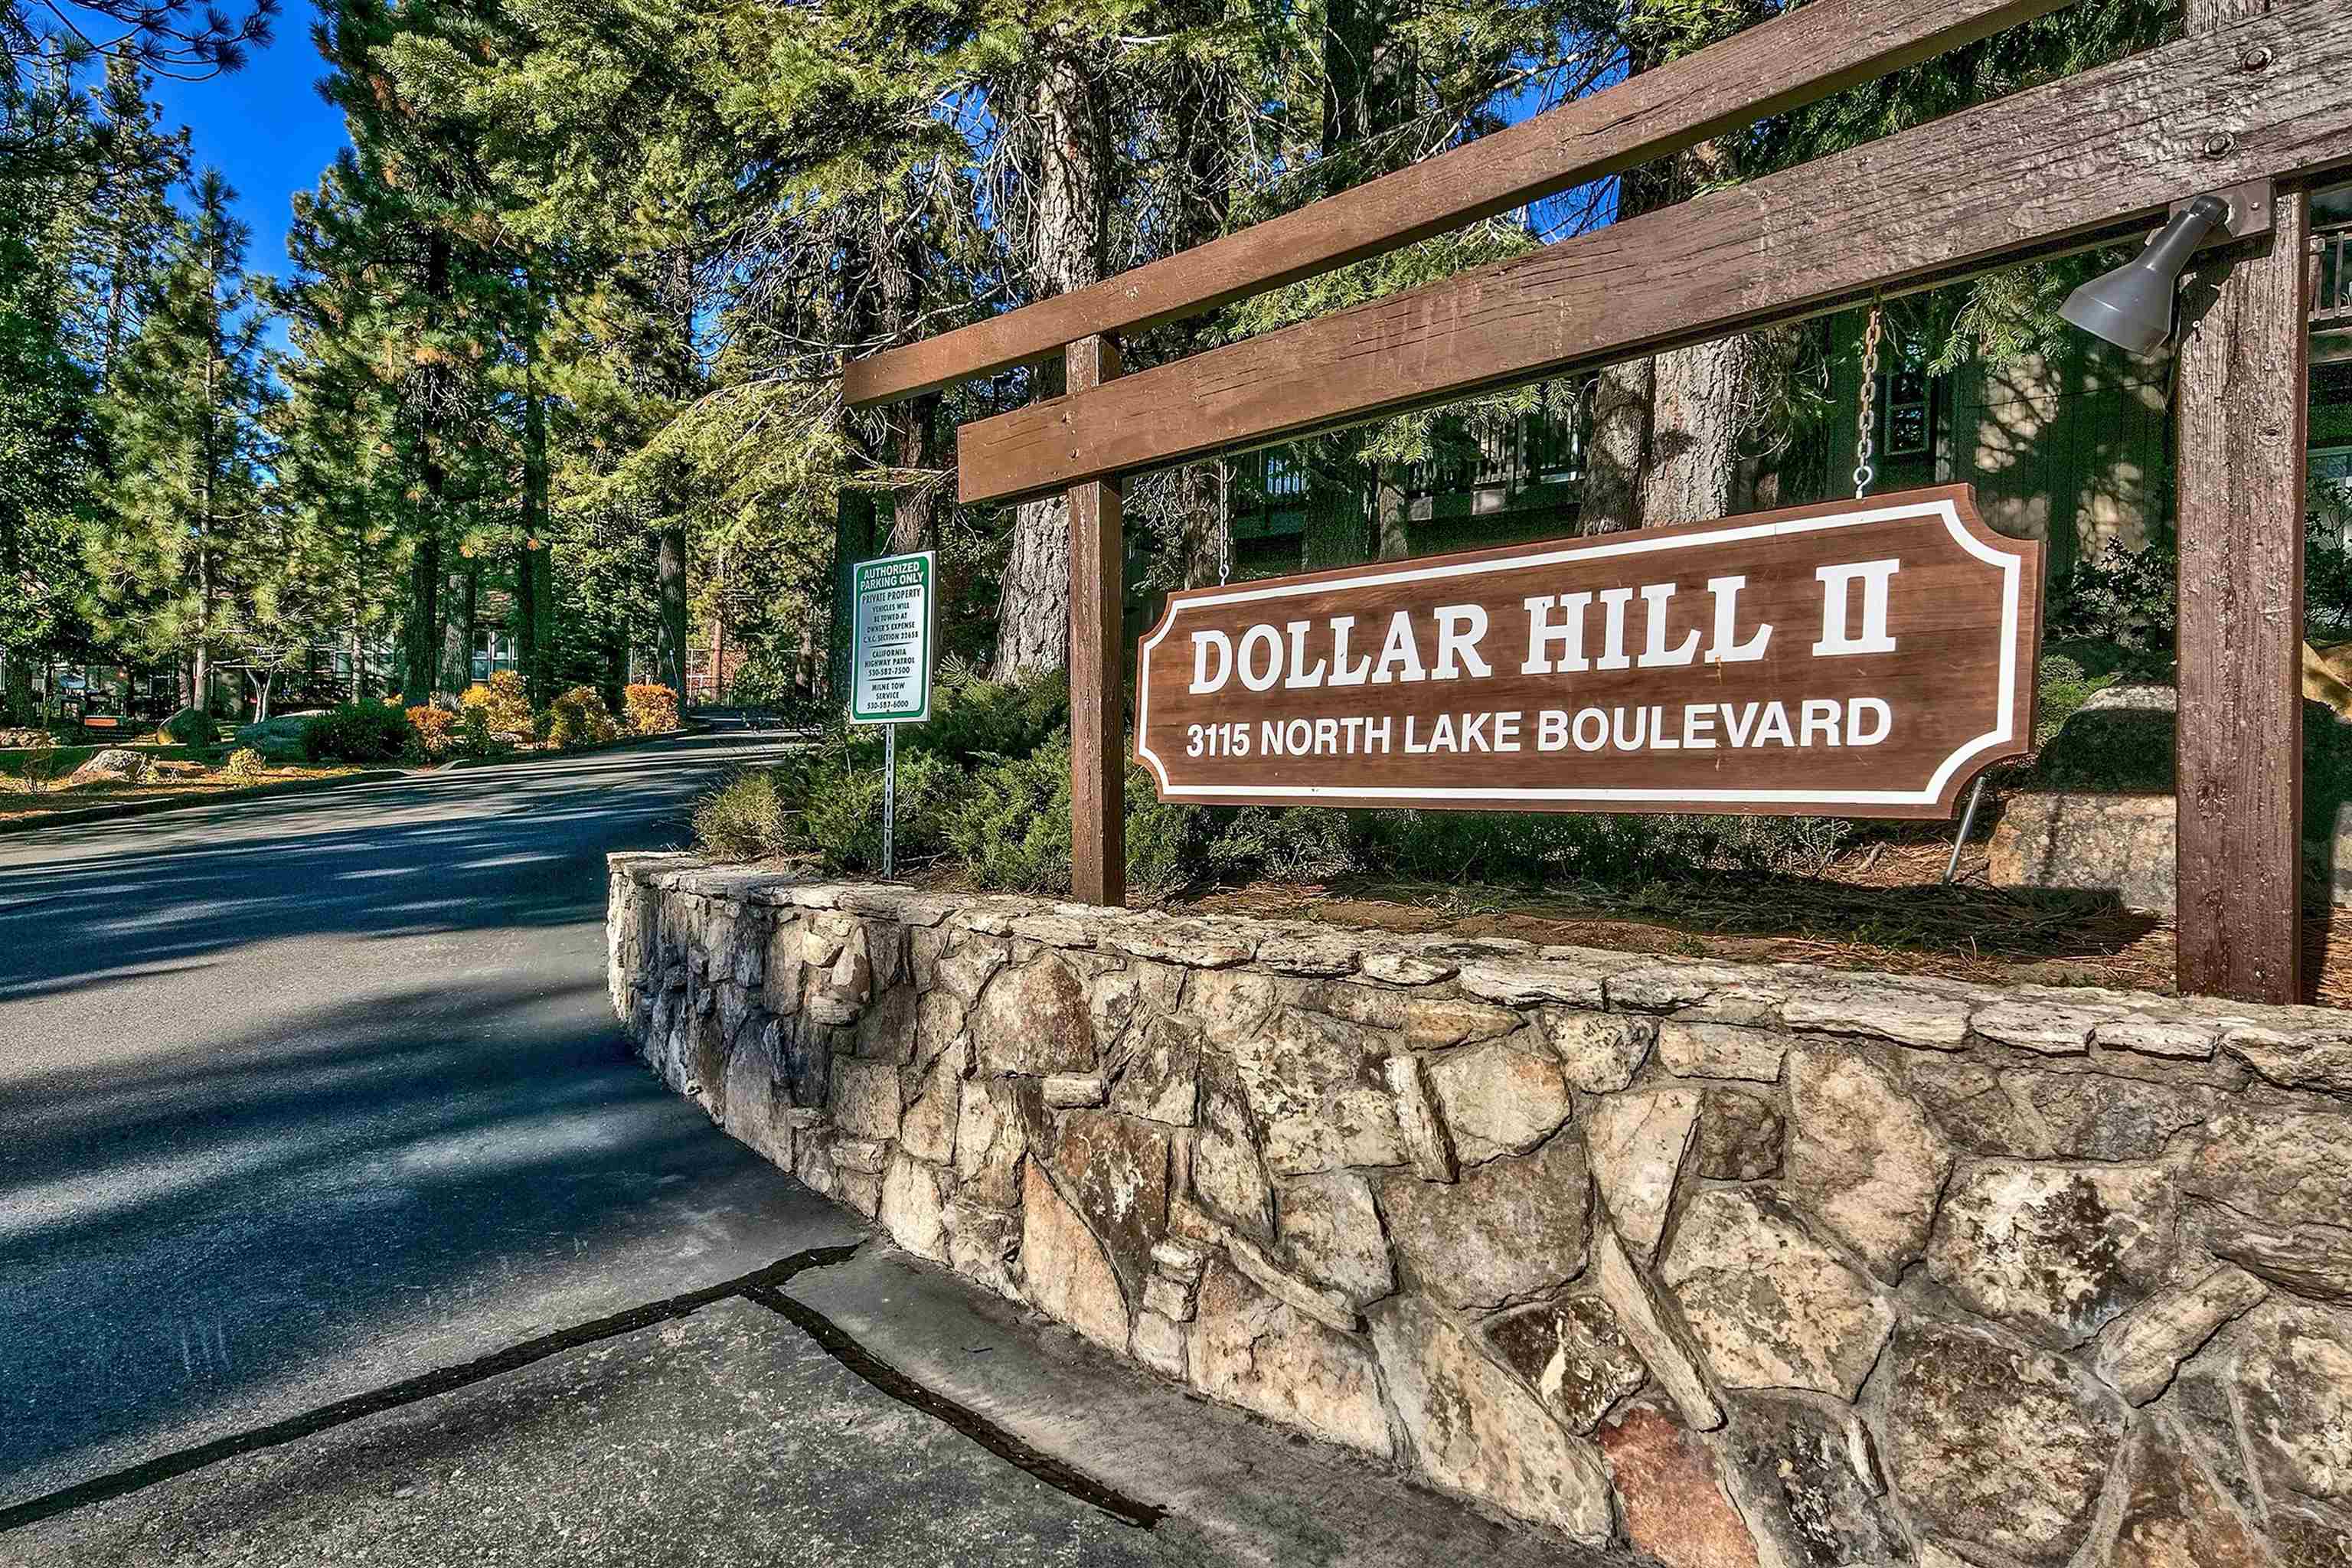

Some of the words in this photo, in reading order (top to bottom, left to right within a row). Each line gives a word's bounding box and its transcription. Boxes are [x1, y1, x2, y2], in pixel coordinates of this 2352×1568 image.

[864, 561, 920, 580] AUTHORIZED
[861, 576, 897, 591] PARKING
[900, 571, 924, 585] ONLY
[862, 593, 886, 605] PRIVATE
[887, 588, 921, 601] PROPERTY
[872, 603, 896, 612] VEHICLES
[897, 602, 910, 610] WILL
[891, 621, 915, 630] EXPENSE
[1190, 605, 1491, 694] DOLLAR
[1522, 576, 1772, 674] HILL
[1813, 559, 1900, 656] II
[878, 633, 900, 642] SECTION
[872, 648, 906, 658] CALIFORNIA
[864, 659, 891, 668] HIGHWAY
[893, 657, 915, 665] PATROL
[871, 683, 890, 691] MILNE
[891, 681, 905, 690] TOW
[876, 691, 900, 701] SERVICE
[1187, 724, 1250, 756] 3115
[1261, 717, 1390, 755] NORTH
[1405, 712, 1521, 753] LAKE
[1538, 698, 1891, 750] BOULEVARD
